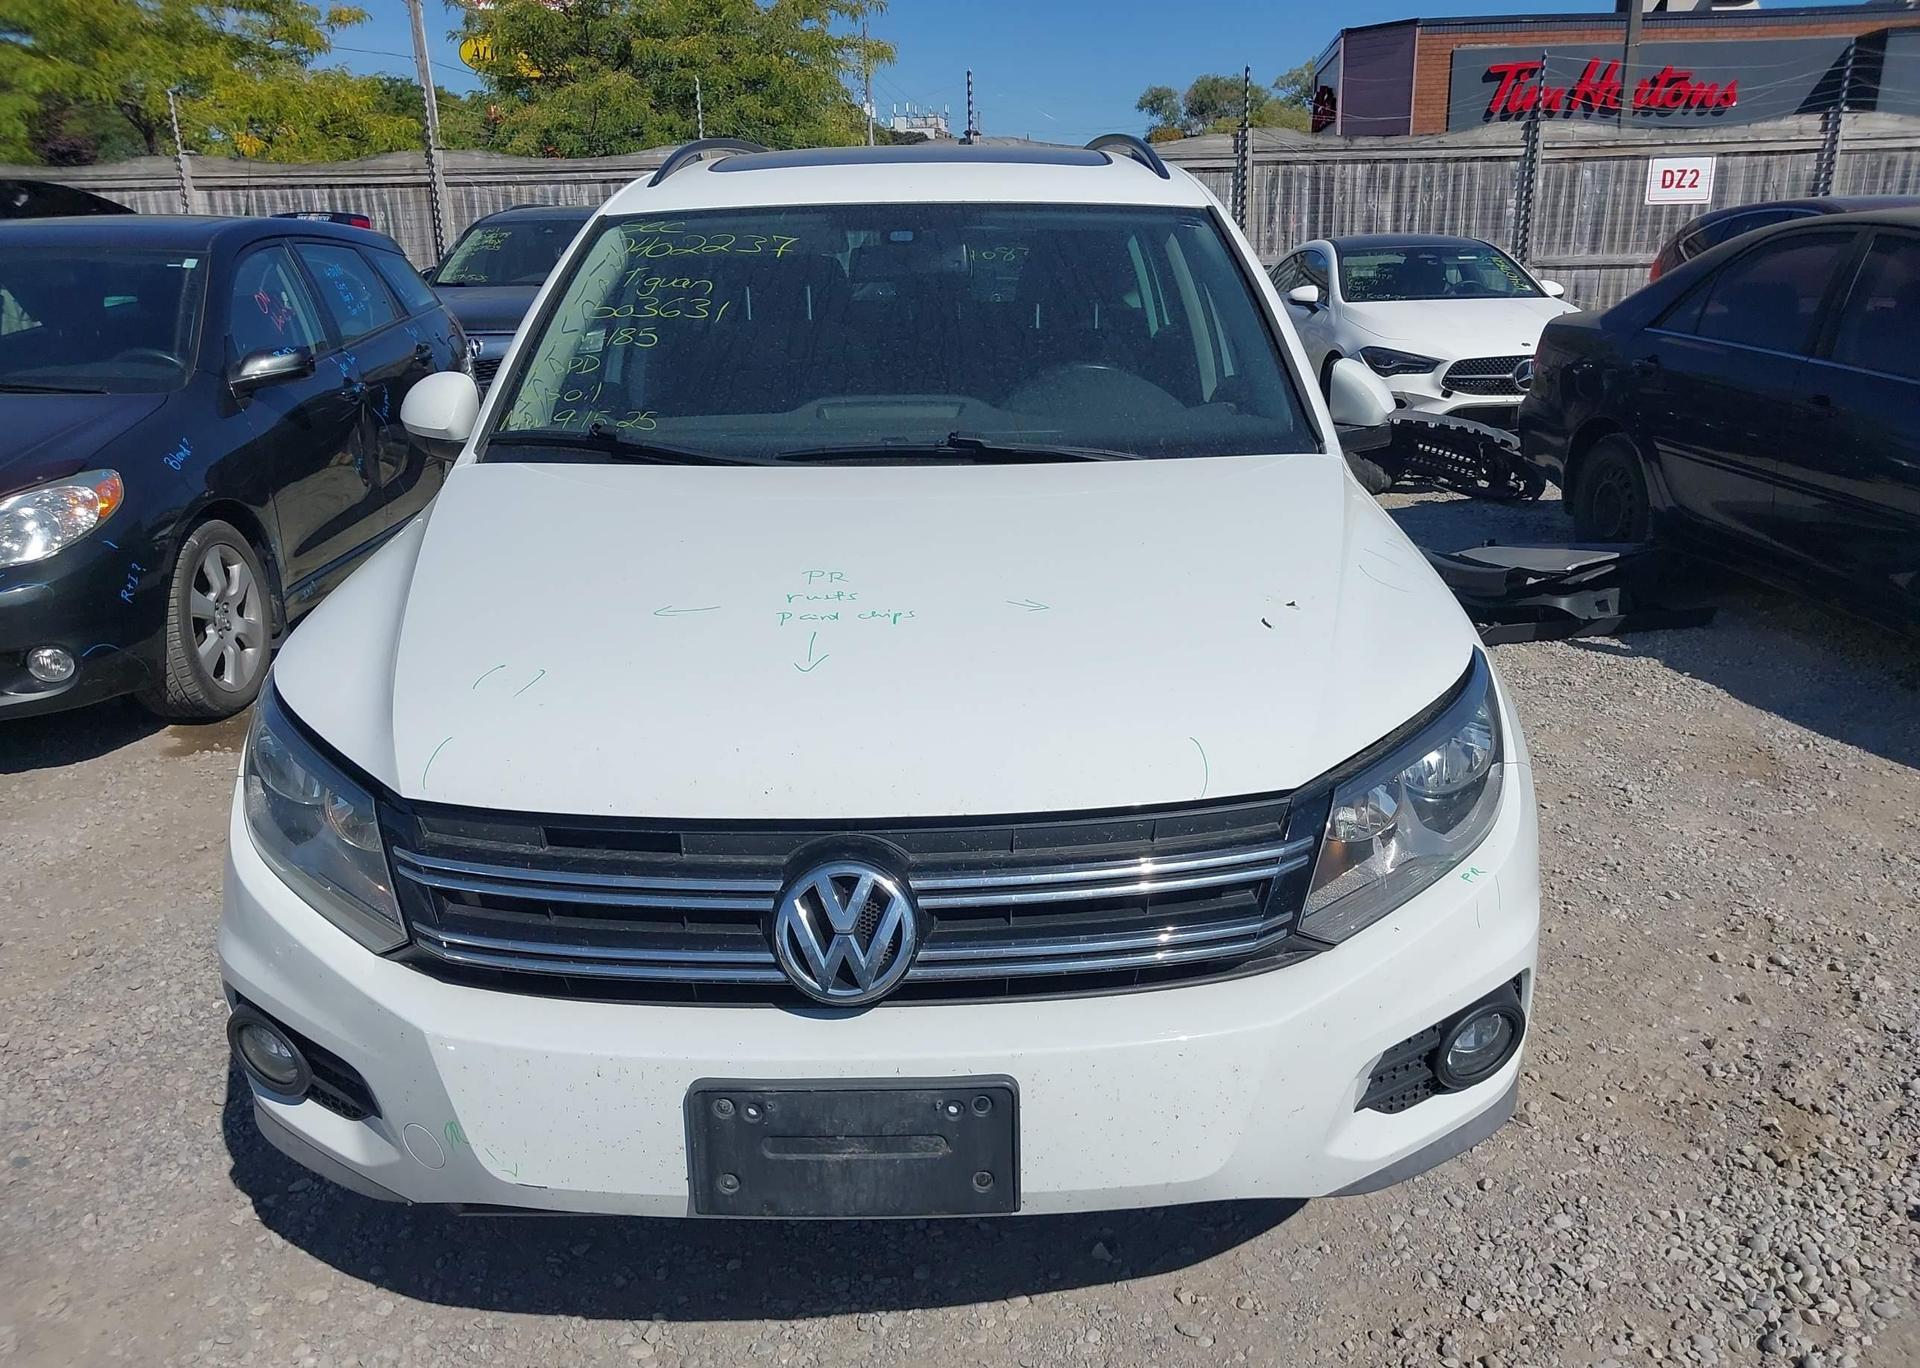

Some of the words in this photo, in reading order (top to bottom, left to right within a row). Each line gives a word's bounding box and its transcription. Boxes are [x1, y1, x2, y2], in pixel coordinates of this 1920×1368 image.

[1487, 60, 1567, 113] Tim
[1661, 168, 1700, 189] DZ2
[623, 267, 713, 297] Tiguan
[801, 570, 849, 585] PR
